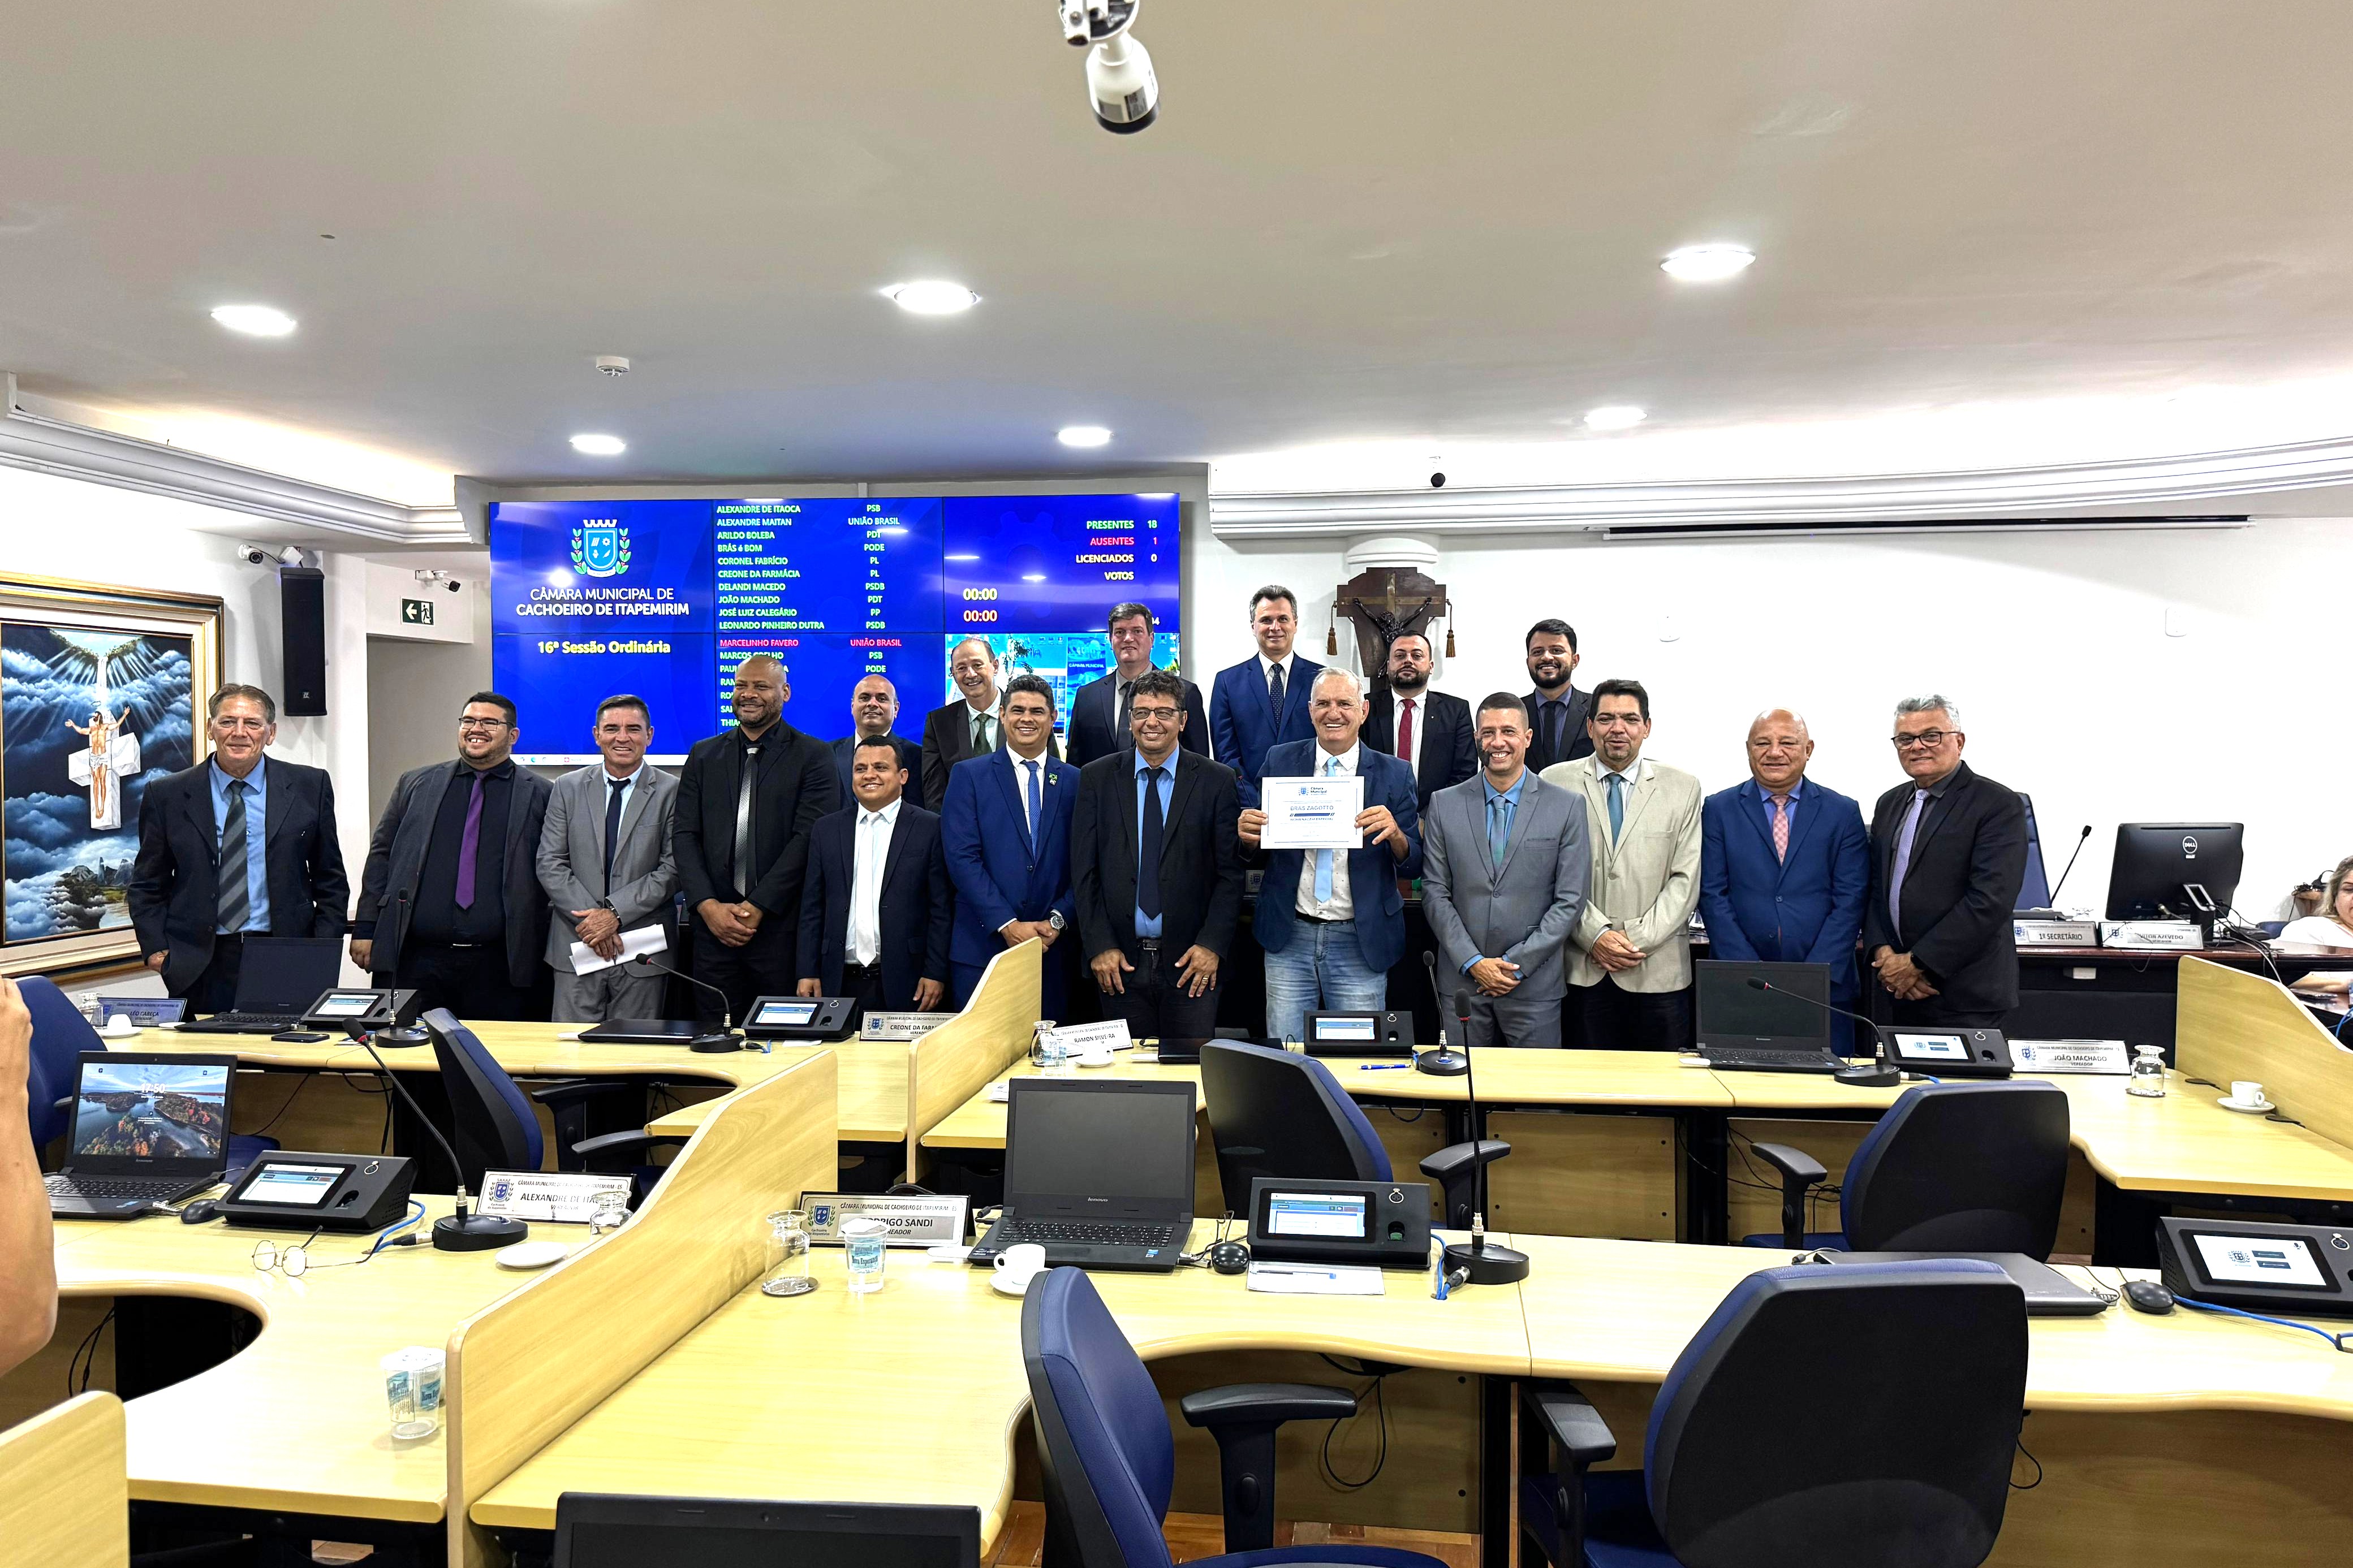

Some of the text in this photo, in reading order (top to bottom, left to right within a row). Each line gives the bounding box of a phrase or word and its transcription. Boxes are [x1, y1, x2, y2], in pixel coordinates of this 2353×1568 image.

[717, 505, 761, 514] ALEXANDRE
[762, 505, 772, 513] DE
[848, 516, 873, 525] UNIÃO
[1086, 520, 1157, 529] PRESENTES 18
[1090, 537, 1134, 546] AUSENTES
[718, 543, 736, 552] BRÁS
[755, 556, 788, 565] FABRÍCIO
[1076, 554, 1157, 563] LICENCIADOS 0
[762, 568, 800, 578] FARMÁCIA
[1104, 572, 1134, 581] VOTOS
[530, 586, 674, 601] CÂMARA MUNICIPAL DE
[963, 588, 998, 601] 00:00
[718, 595, 739, 604] JOÃO
[516, 603, 689, 616] CACHOEIRO DE ITAPEMIRIM
[718, 607, 736, 617] JOSÉ
[756, 607, 797, 617] CALEGÁRIO
[963, 610, 998, 622] 00:00
[719, 621, 761, 630] LEONARDO
[866, 621, 885, 629] PSDB
[850, 638, 875, 646] UNIÃO
[538, 640, 671, 654] 16ª Sessão Ordinária
[141, 1083, 166, 1094] 17:50
[520, 1193, 568, 1203] ALEXANDRE
[904, 1219, 933, 1227] SANDI
